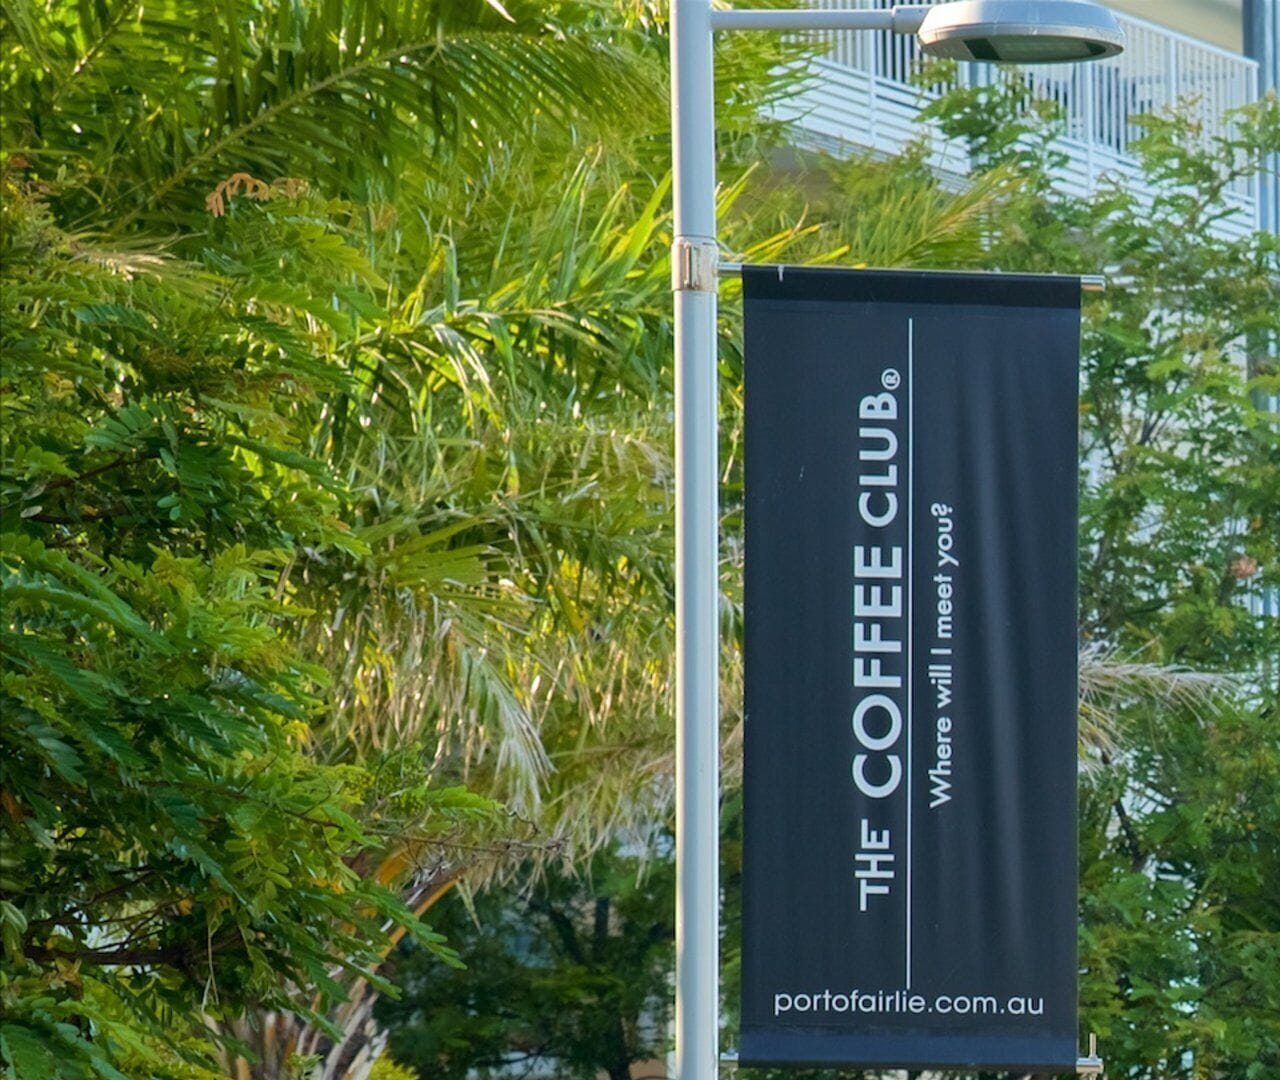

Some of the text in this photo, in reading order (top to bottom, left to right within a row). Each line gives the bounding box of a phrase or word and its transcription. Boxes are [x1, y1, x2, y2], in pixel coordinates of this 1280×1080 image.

[931, 502, 960, 567] you?
[933, 573, 952, 639] meet
[852, 545, 902, 798] COFFEE
[928, 664, 952, 709] will
[928, 716, 952, 808] Where
[855, 818, 895, 912] THE
[774, 989, 1044, 1016] portofairlie.com.au
